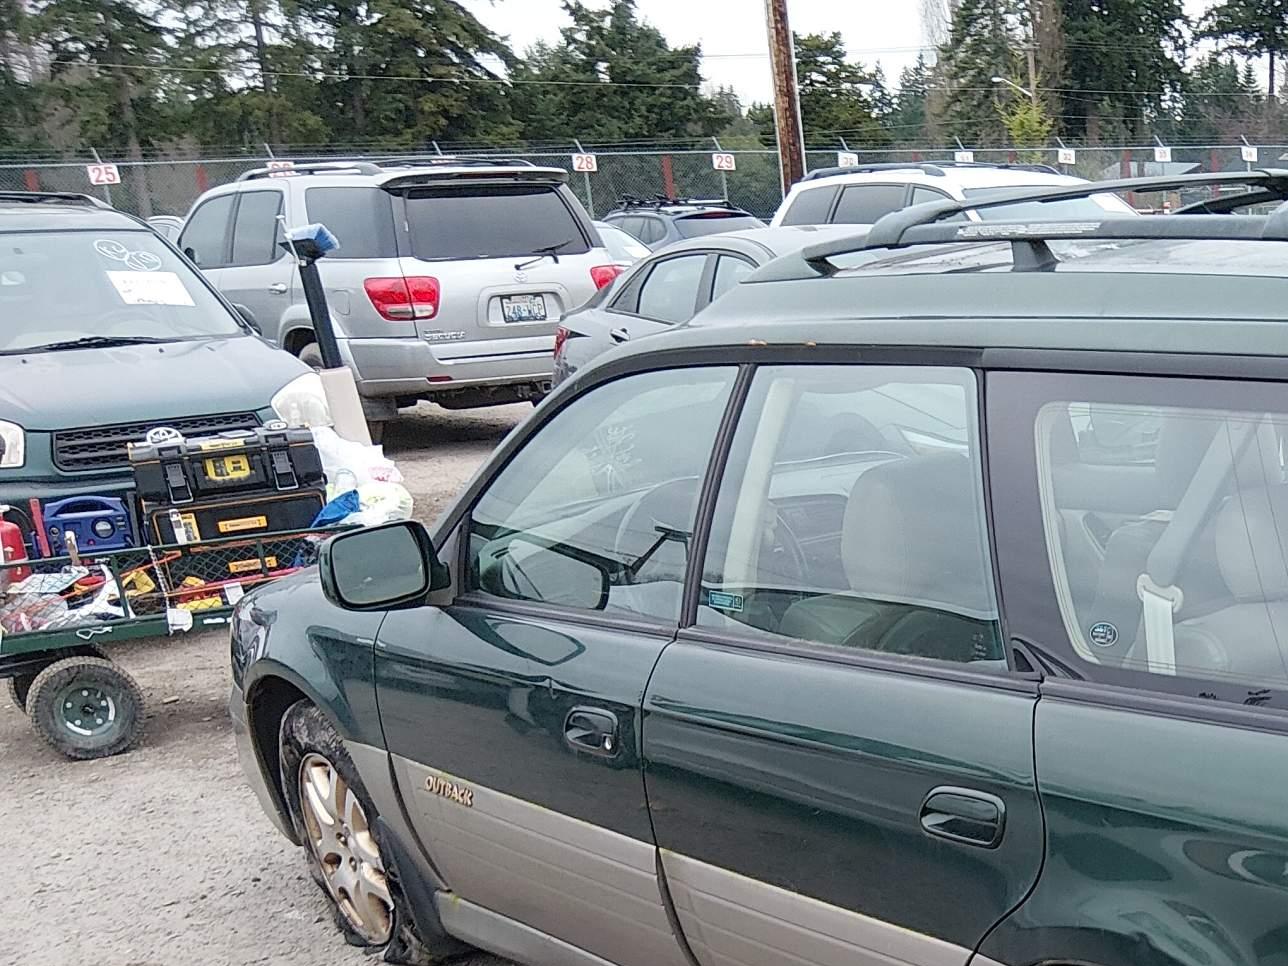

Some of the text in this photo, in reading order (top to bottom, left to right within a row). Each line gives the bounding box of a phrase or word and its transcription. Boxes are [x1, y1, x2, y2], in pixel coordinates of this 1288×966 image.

[575, 155, 595, 170] 28
[716, 154, 735, 170] 29
[92, 166, 116, 183] 25
[424, 775, 474, 808] OUTBACK
